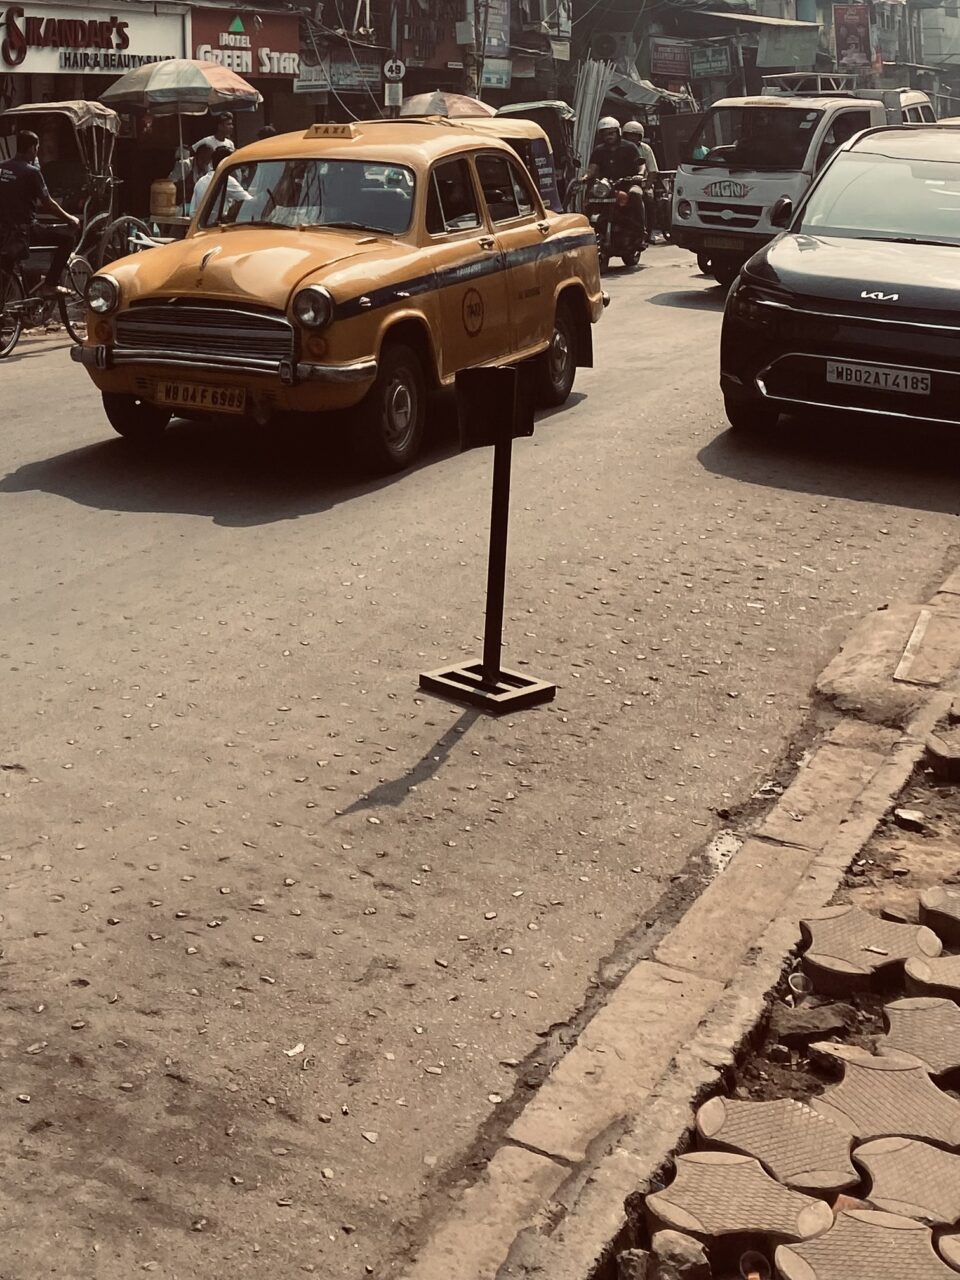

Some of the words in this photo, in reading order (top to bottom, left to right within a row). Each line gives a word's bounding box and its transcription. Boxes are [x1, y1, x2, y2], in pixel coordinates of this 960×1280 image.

[2, 6, 130, 66] SIKANDAR'S
[219, 32, 251, 48] HOTEL
[62, 51, 90, 68] HAIR
[92, 52, 100, 68] &
[103, 53, 142, 69] BEAUTY
[195, 44, 253, 73] GREEN
[258, 47, 300, 74] STAR
[314, 127, 346, 135] TAXI
[835, 366, 929, 391] WB02AT4185
